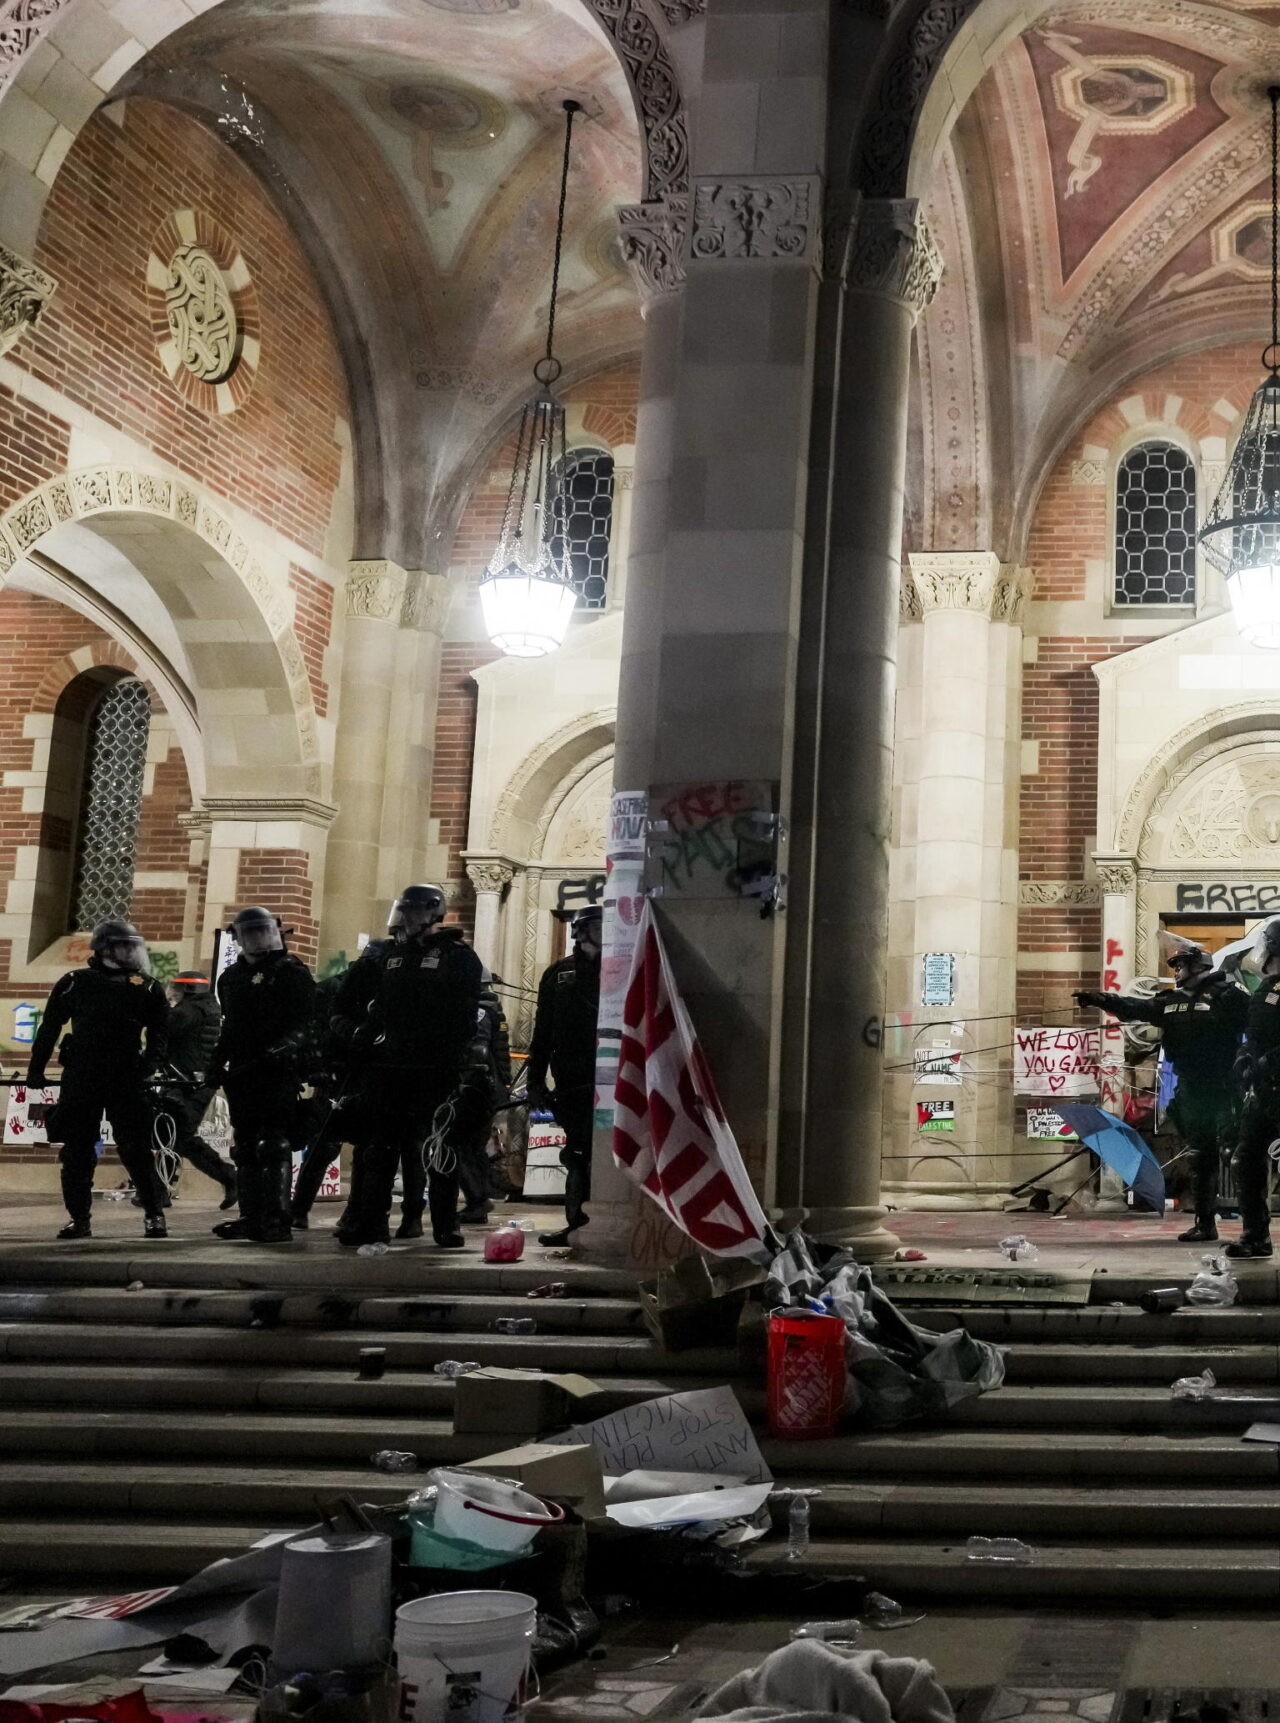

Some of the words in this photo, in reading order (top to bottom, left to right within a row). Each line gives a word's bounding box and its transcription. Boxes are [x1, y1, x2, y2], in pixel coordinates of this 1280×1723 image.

[1016, 1030, 1051, 1052] WE
[1053, 1029, 1101, 1052] LOVE
[1023, 1055, 1056, 1079] YOU
[1058, 1055, 1100, 1081] GAZA
[920, 1101, 949, 1113] FREE
[917, 1121, 954, 1131] PALESTINE
[884, 1273, 1056, 1290] ALESTINE
[670, 1402, 735, 1445] STOP
[686, 1428, 749, 1471] ANTI
